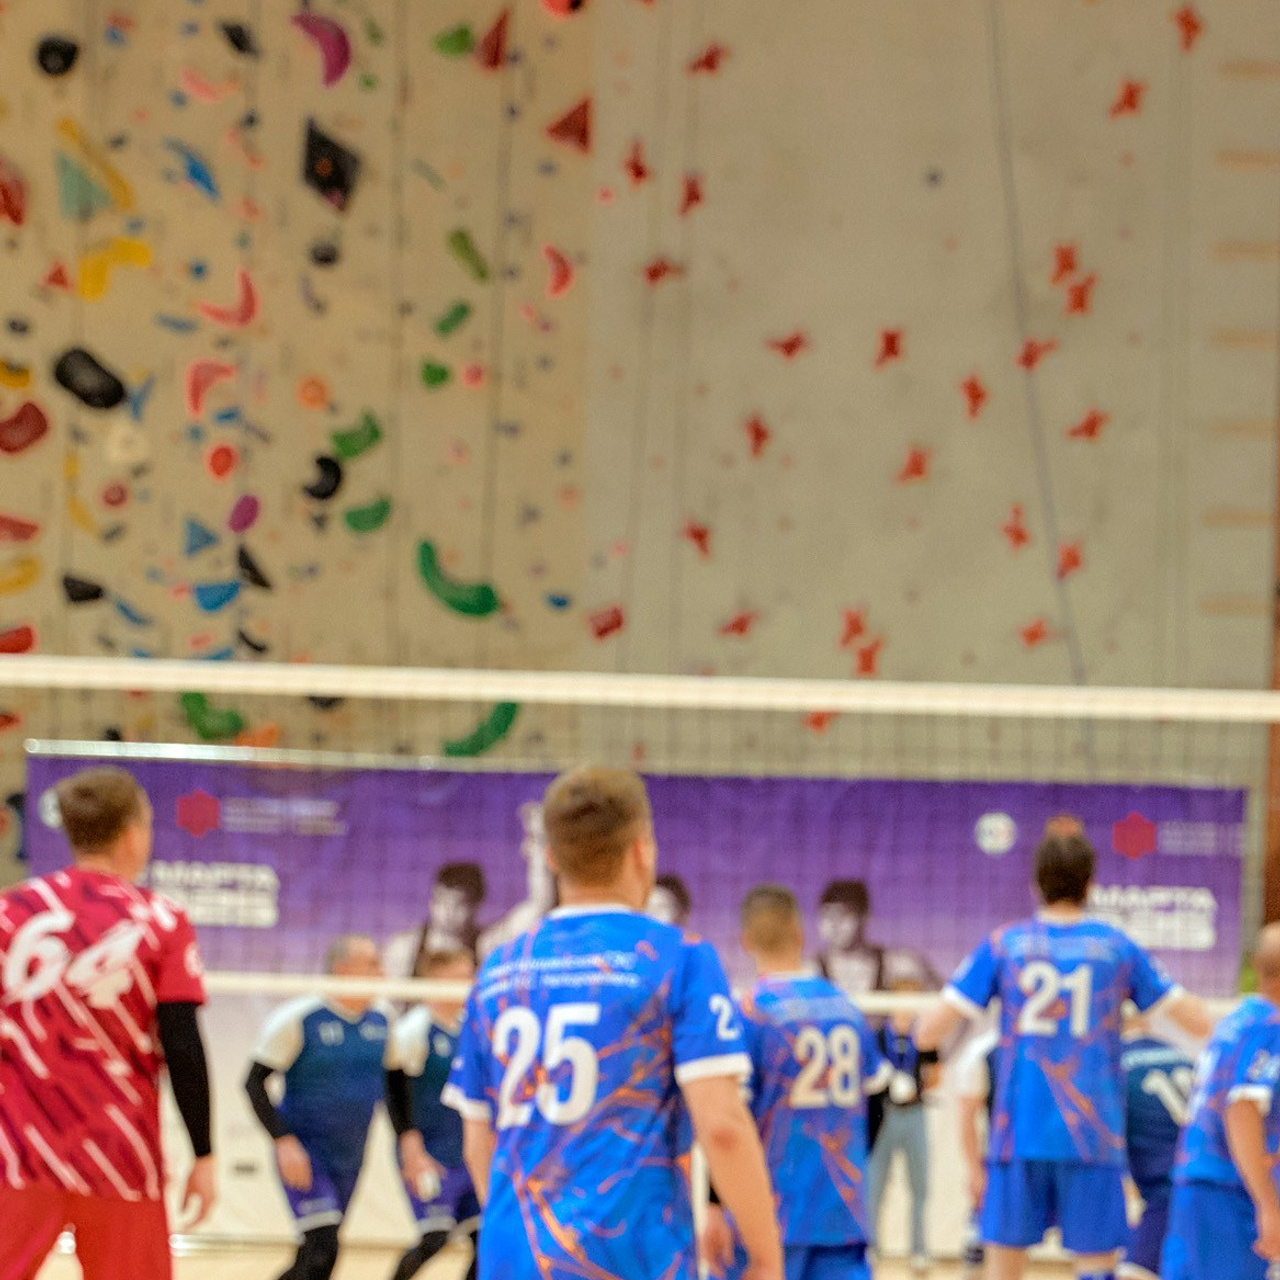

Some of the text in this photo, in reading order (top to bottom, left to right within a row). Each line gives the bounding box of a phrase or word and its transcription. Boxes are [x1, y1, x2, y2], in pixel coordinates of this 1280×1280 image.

[1016, 961, 1091, 1038] 21
[492, 1002, 600, 1130] 25
[789, 1023, 861, 1109] 28
